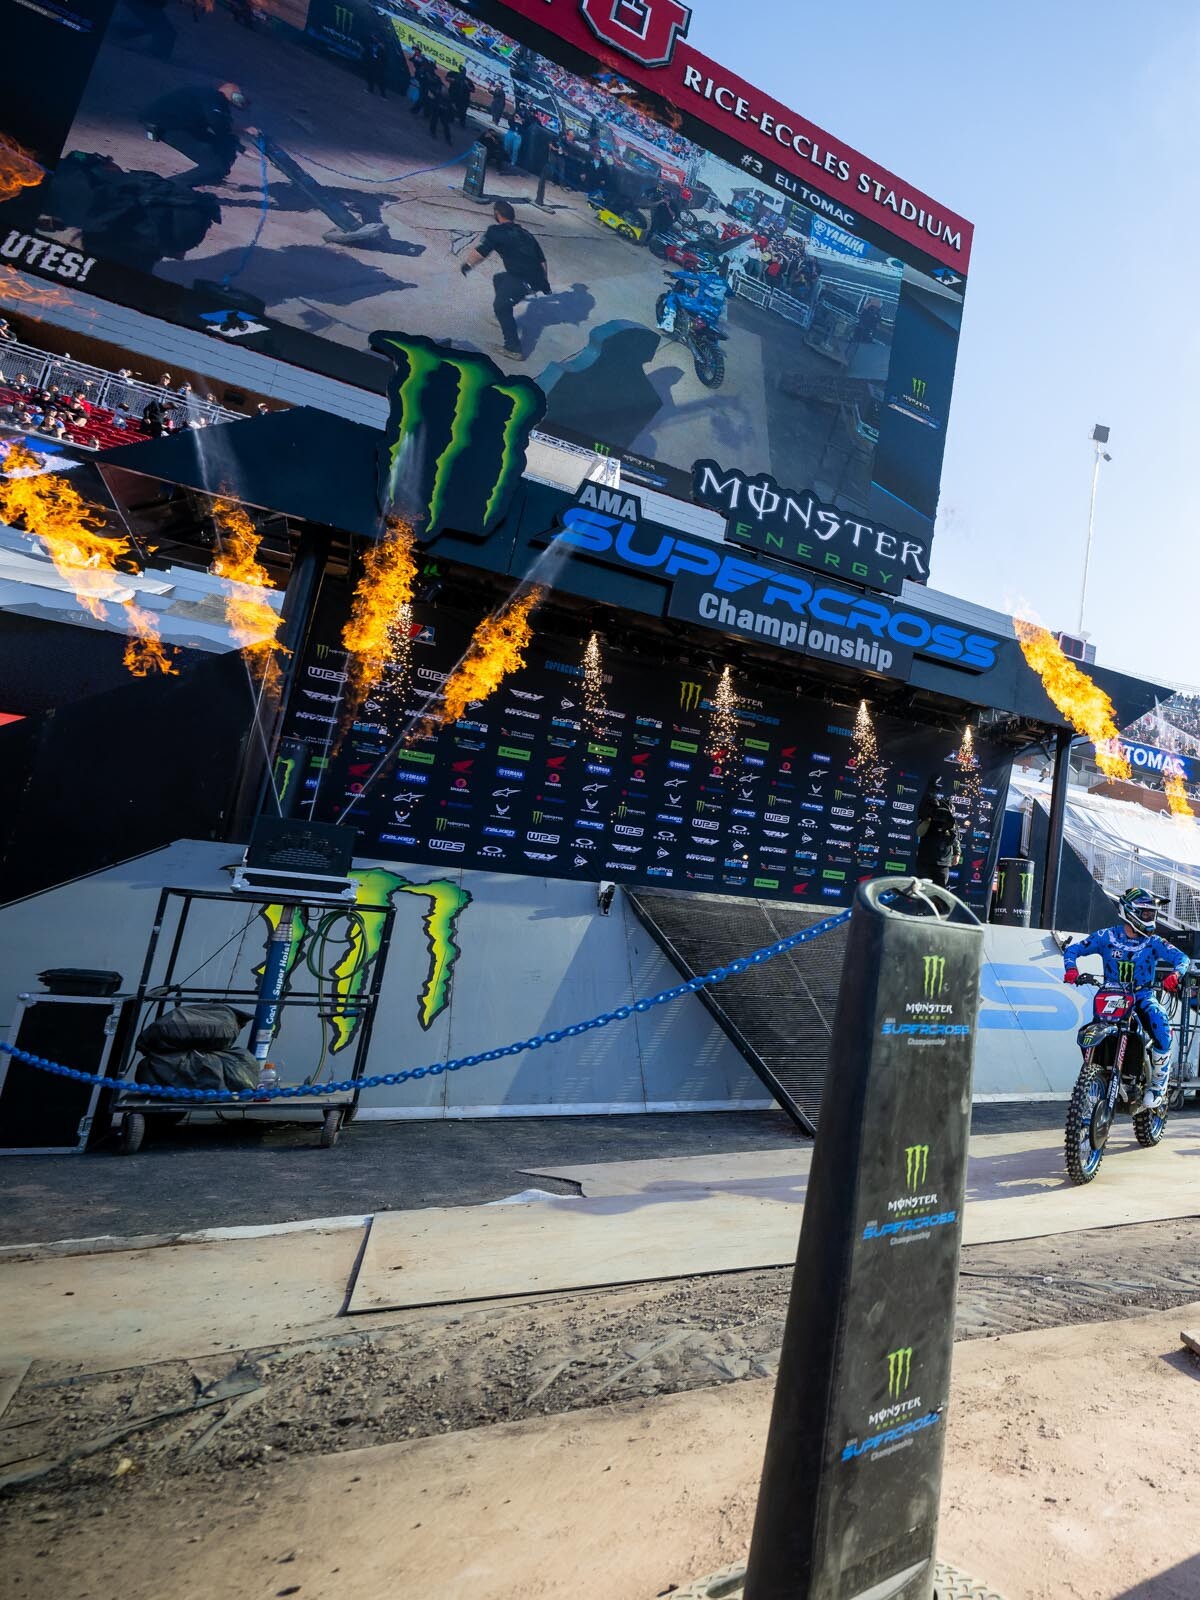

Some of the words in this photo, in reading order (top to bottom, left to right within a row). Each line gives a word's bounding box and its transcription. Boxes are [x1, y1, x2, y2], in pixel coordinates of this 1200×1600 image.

[407, 34, 462, 69] Kawasak
[683, 64, 850, 181] RICE-ECCLES
[857, 172, 962, 252] STADIUM
[739, 153, 764, 174] #3
[775, 172, 798, 193] ELI
[801, 188, 855, 227] TOMAC
[825, 226, 865, 254] YAMAHA
[0, 230, 97, 282] UTES!
[578, 485, 637, 522] AMA
[699, 467, 926, 575] MONSTER
[736, 523, 894, 585] ENERGY
[554, 506, 1000, 670] SUPERCROSS
[698, 591, 893, 673] Championship
[1123, 744, 1186, 777] TOMAC
[763, 812, 790, 824] WPS
[830, 806, 855, 818] WPS
[892, 800, 915, 812] WPS
[526, 831, 560, 845] WPS
[614, 824, 645, 837] WPS
[691, 818, 720, 831] WPS
[428, 838, 466, 853] WPS
[265, 998, 278, 1025] Geni
[279, 941, 291, 968] Hoist
[905, 1002, 953, 1015] MONSTER
[881, 1023, 970, 1036] SUPERCROSS
[1108, 1075, 1118, 1109] DUNLOP
[888, 1193, 938, 1212] MONSTER
[863, 1210, 957, 1240] SUPERCROSS
[868, 1396, 922, 1425] MONSTER
[841, 1412, 941, 1463] SUPERCROSS
